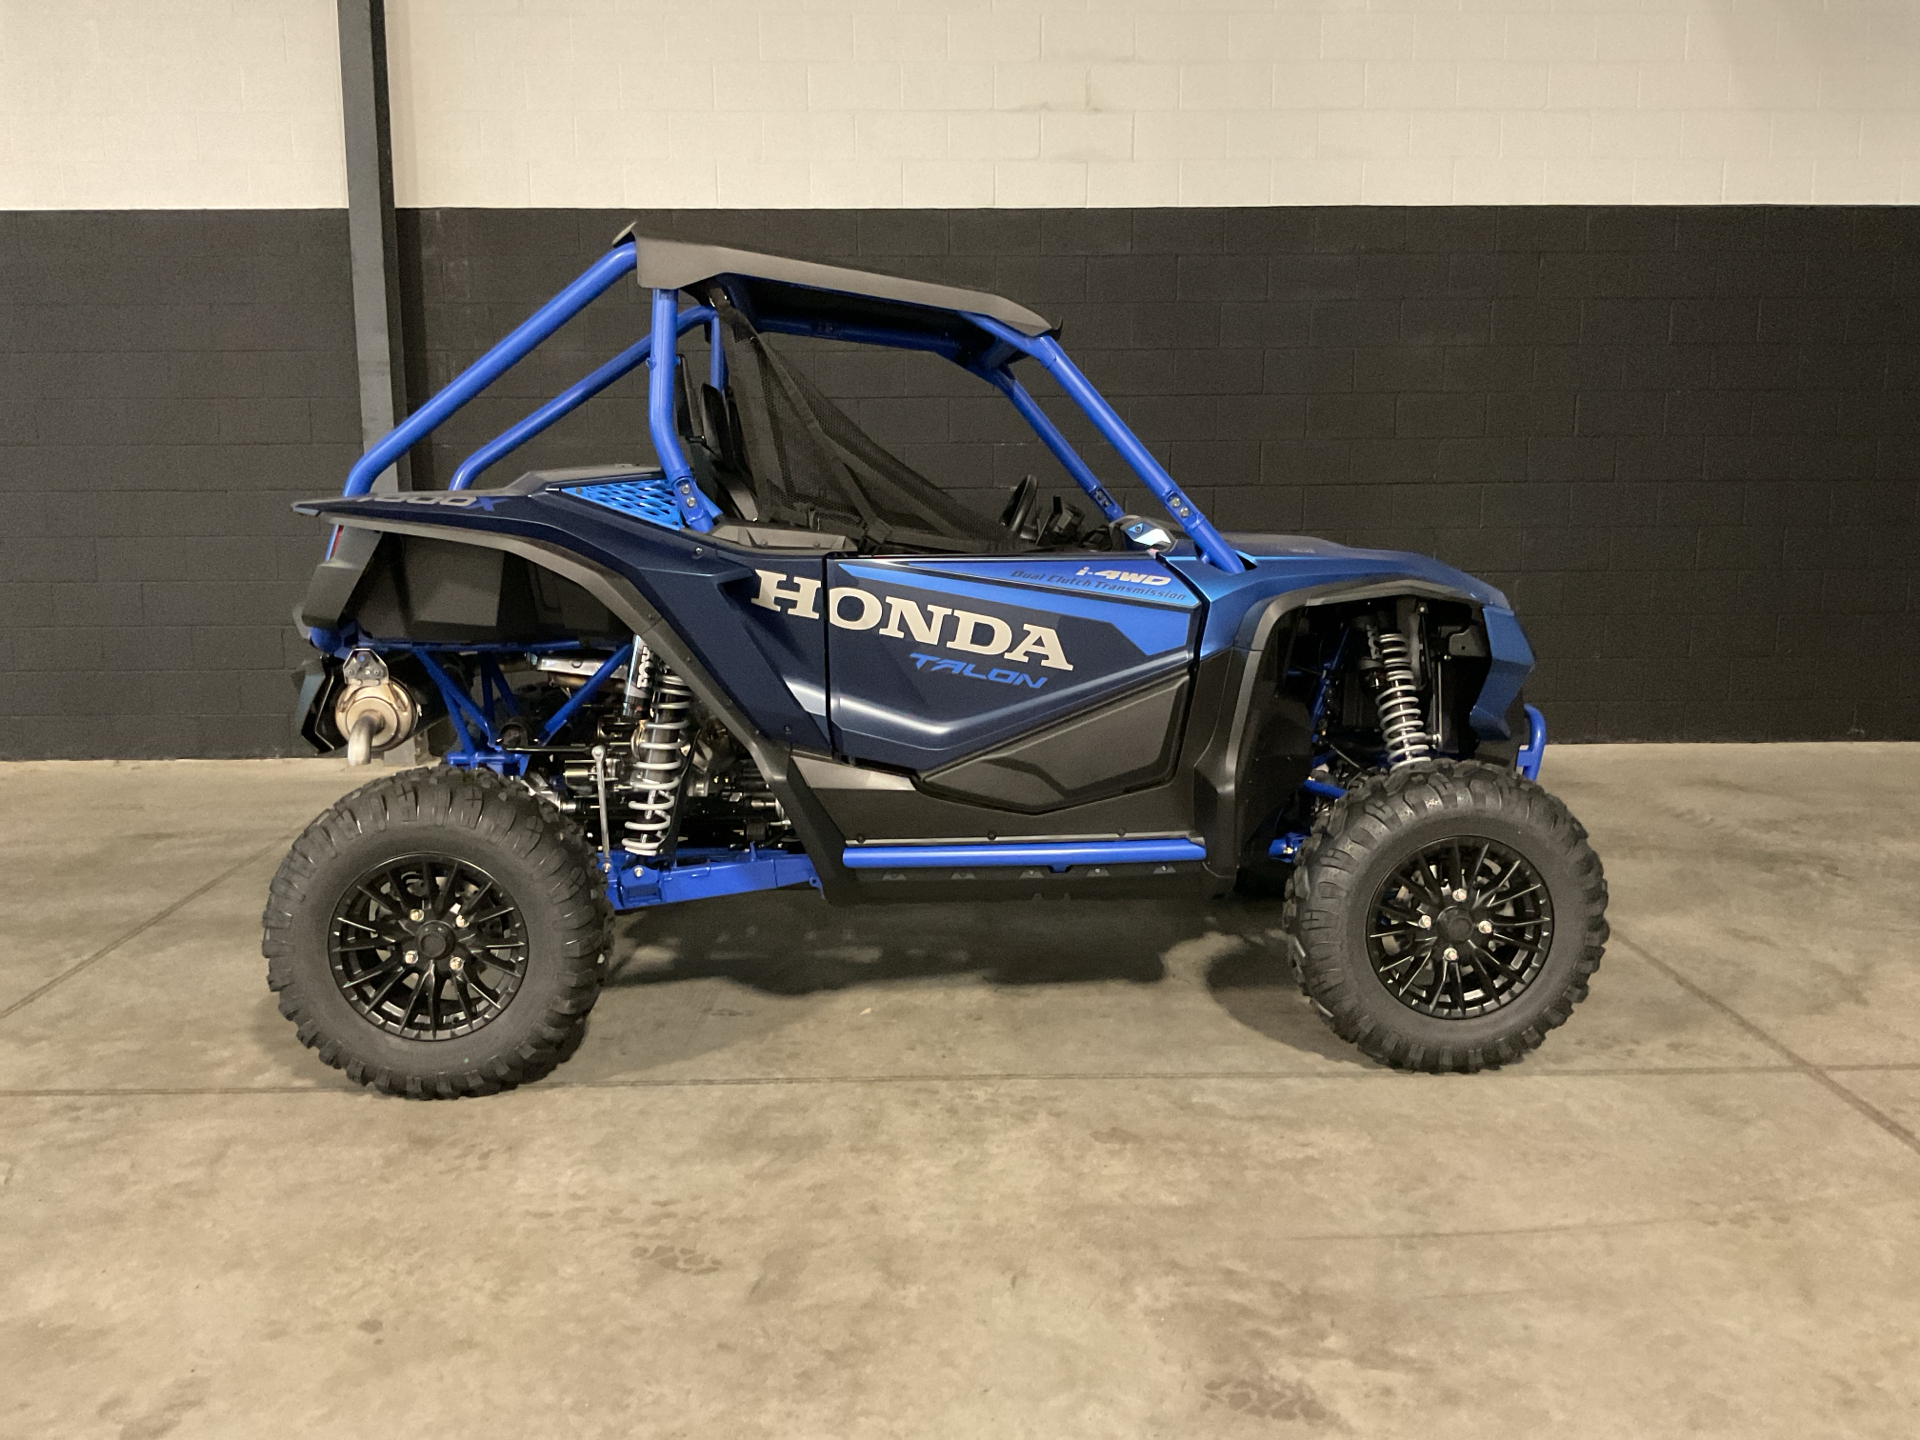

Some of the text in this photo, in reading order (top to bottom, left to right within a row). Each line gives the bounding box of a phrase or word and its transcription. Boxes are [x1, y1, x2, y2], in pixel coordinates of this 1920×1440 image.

[1011, 569, 1187, 601] Dual Clutch Transmission
[1076, 566, 1171, 586] i-4WD
[751, 569, 1074, 671] HONDA
[909, 652, 1048, 689] TALON
